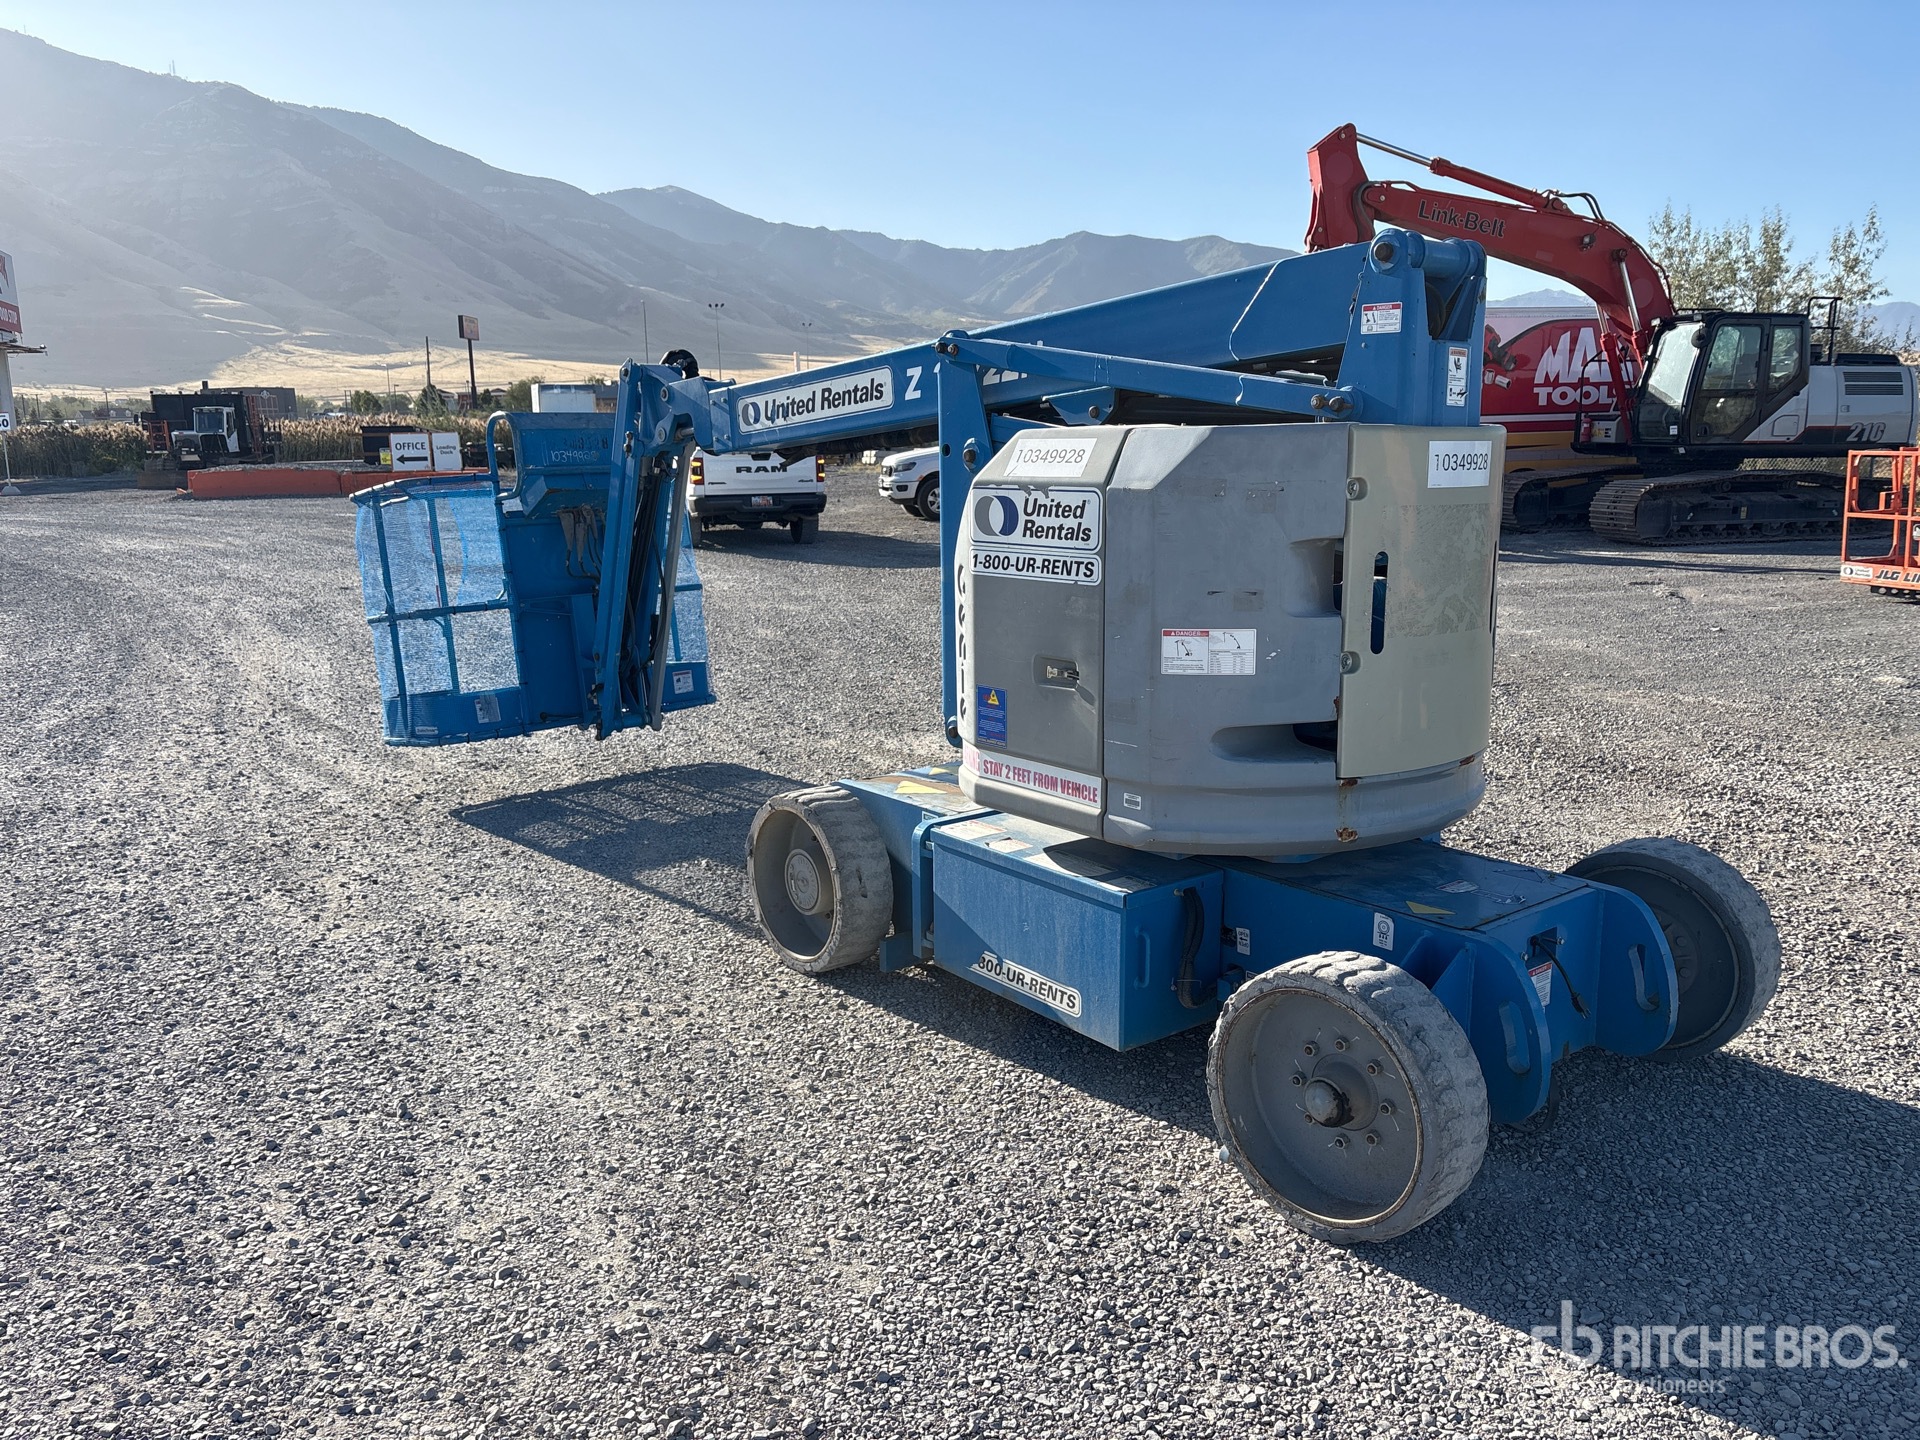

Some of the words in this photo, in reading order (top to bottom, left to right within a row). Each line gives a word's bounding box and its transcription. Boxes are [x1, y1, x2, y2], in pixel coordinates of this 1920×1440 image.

[1418, 200, 1505, 237] Link-Belt
[904, 366, 922, 400] Z
[764, 390, 816, 421] United
[821, 378, 884, 411] Rentals
[1533, 384, 1620, 406] TOOL
[395, 442, 426, 450] OFFICE
[1015, 449, 1086, 464] 10349928
[1434, 453, 1489, 471] 10349928
[1023, 498, 1087, 519] United
[1022, 519, 1092, 542] Rentals
[972, 553, 1095, 578] 1-800-UR-RENTS
[1875, 570, 1900, 580] JLG
[983, 759, 1003, 777] STAY
[1005, 764, 1011, 779] 2
[1013, 766, 1032, 784] FEET
[1033, 772, 1058, 793] FROM
